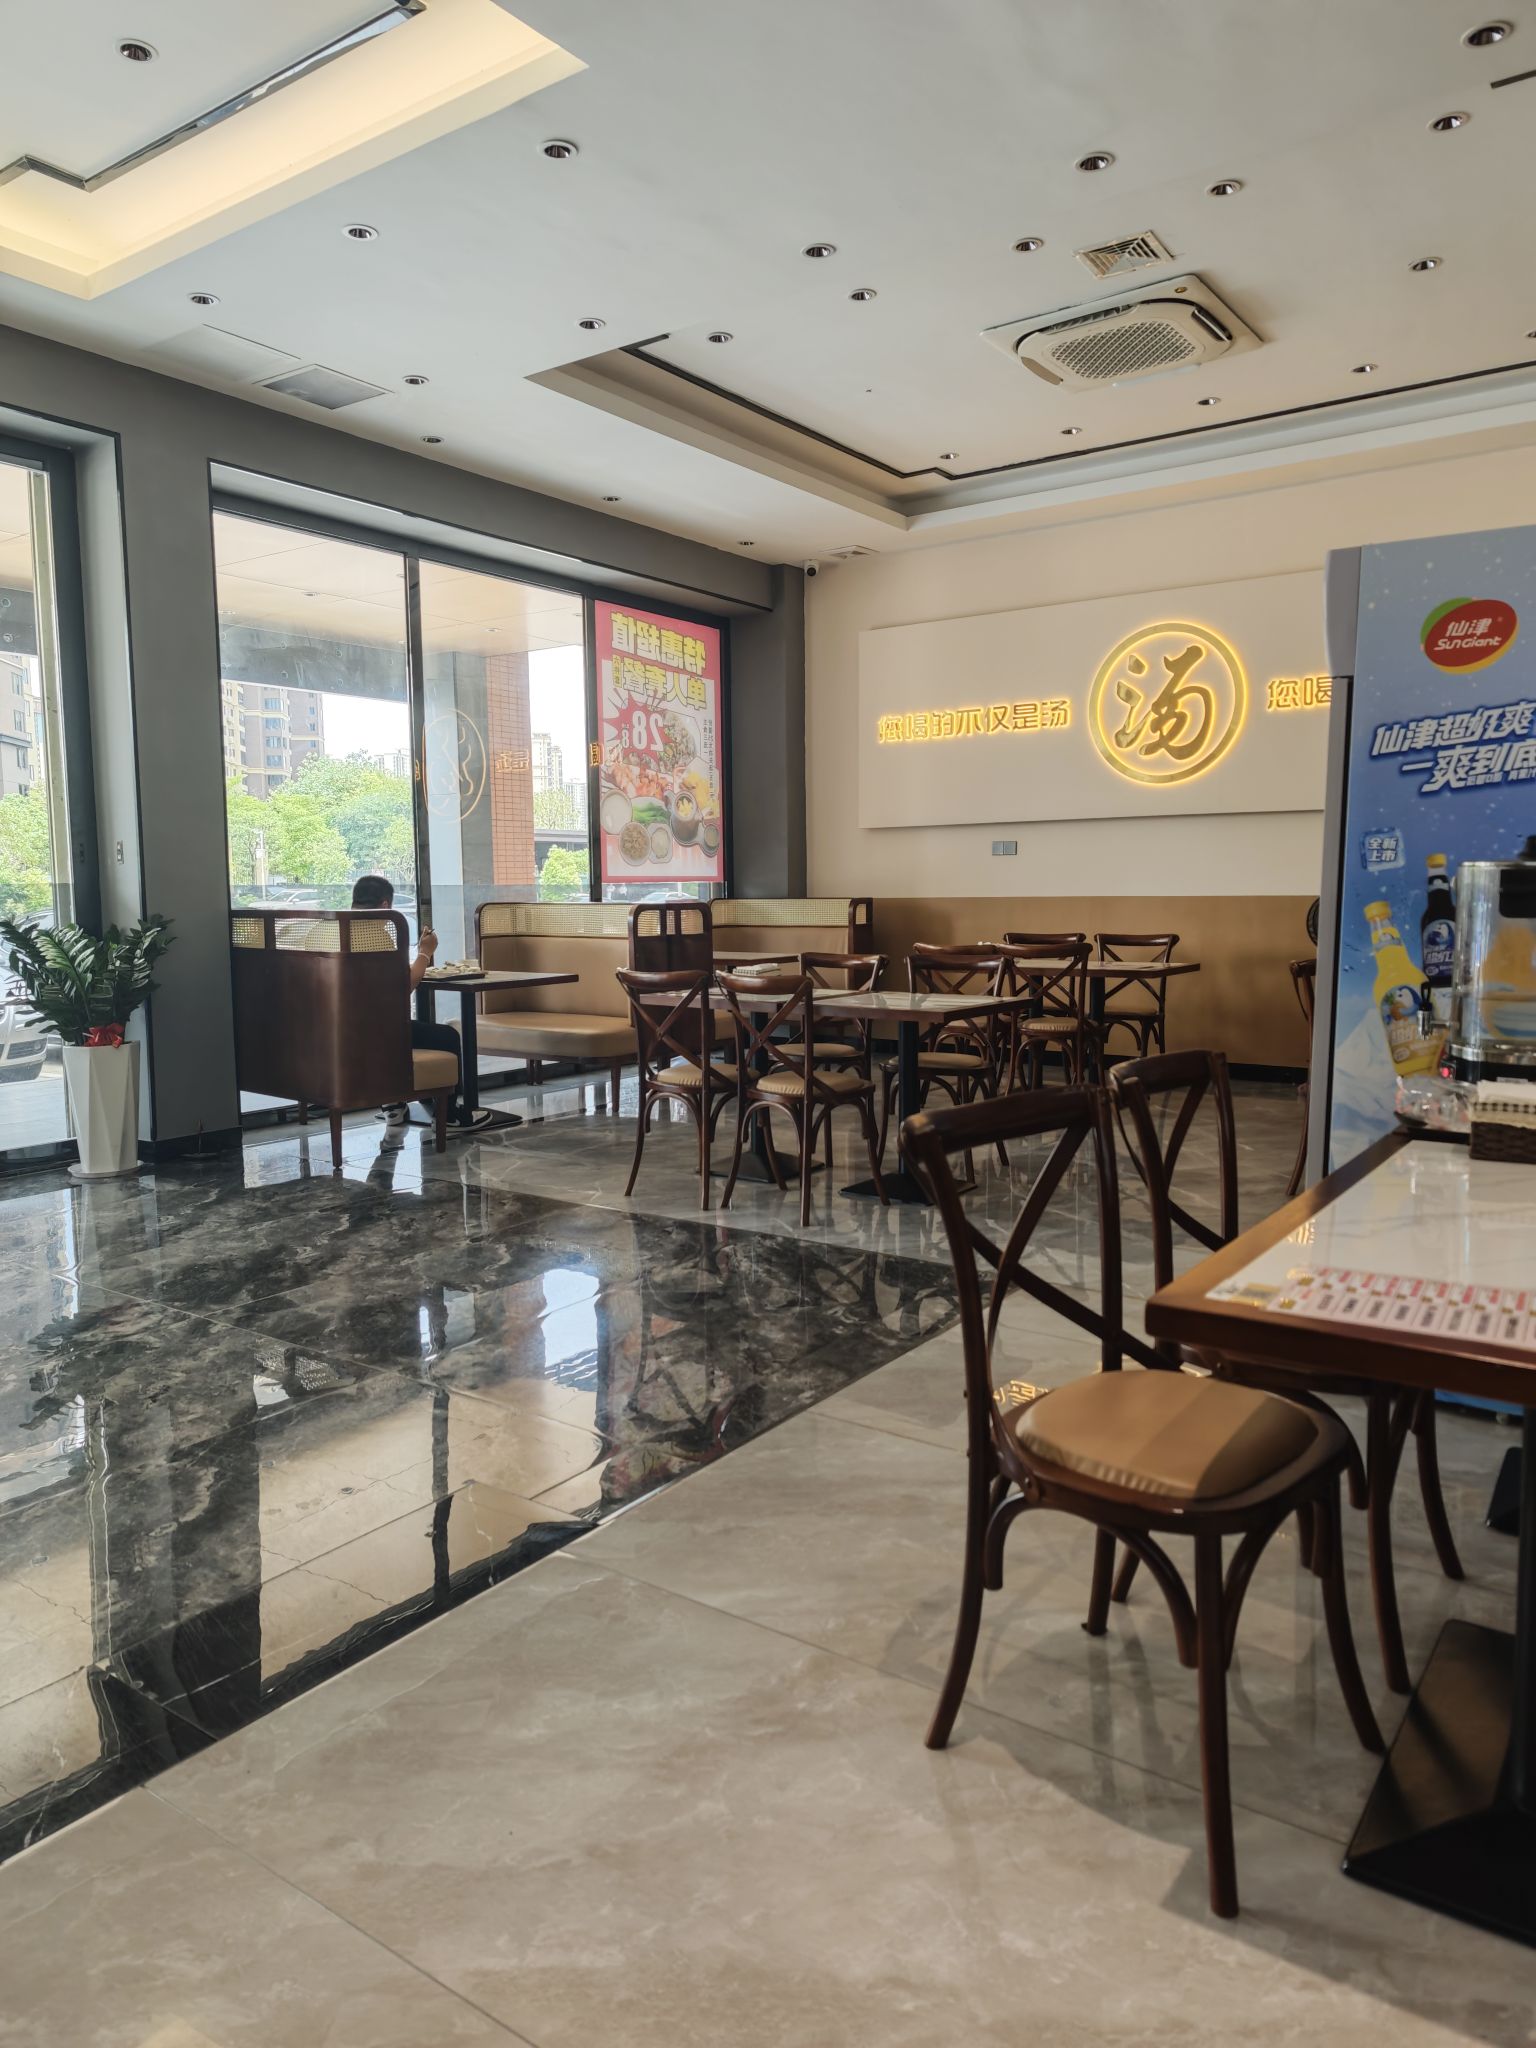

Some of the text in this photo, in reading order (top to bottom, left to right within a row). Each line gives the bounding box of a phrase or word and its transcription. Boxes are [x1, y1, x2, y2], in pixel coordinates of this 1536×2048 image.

[1446, 618, 1493, 638] 仙津
[1434, 635, 1502, 651] SunGiant
[1267, 676, 1332, 710] 您喝
[879, 699, 1069, 743] 您喝的不仅是汤
[1368, 836, 1398, 850] 全新
[1368, 850, 1397, 863] 上市
